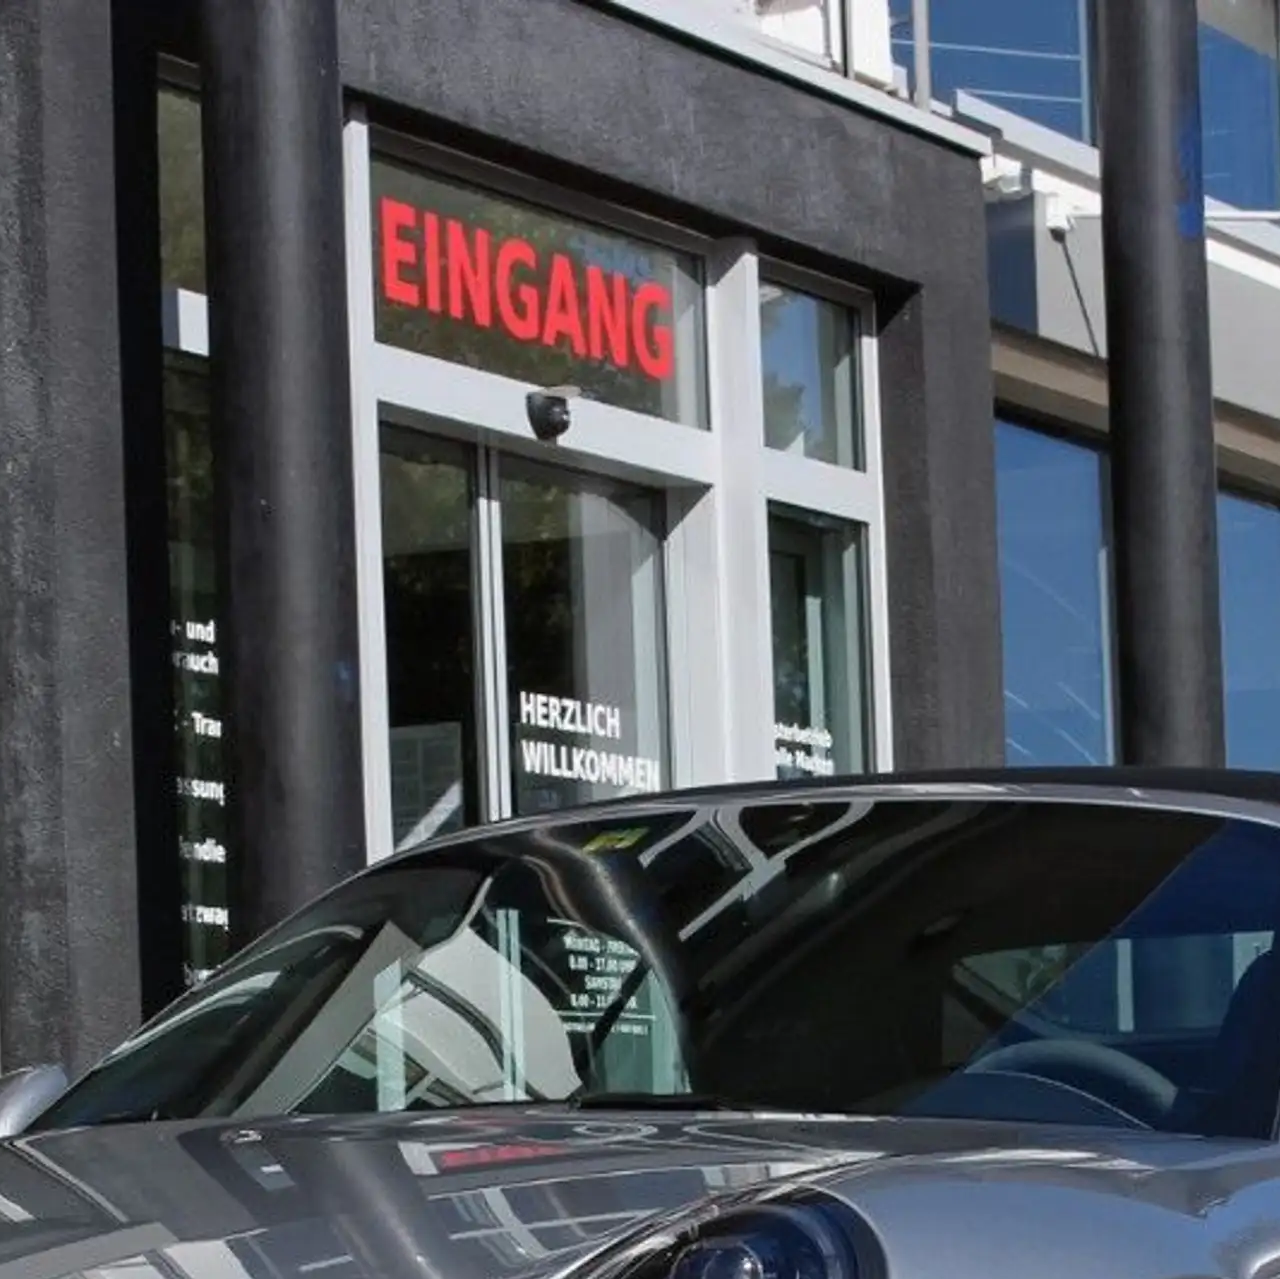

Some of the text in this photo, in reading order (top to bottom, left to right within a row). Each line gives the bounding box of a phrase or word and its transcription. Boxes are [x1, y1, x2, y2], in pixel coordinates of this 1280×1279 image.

[380, 196, 674, 379] EINGANG
[185, 619, 216, 644] und
[520, 690, 621, 738] HERZLICH
[521, 739, 661, 793] WILLKOMMEN
